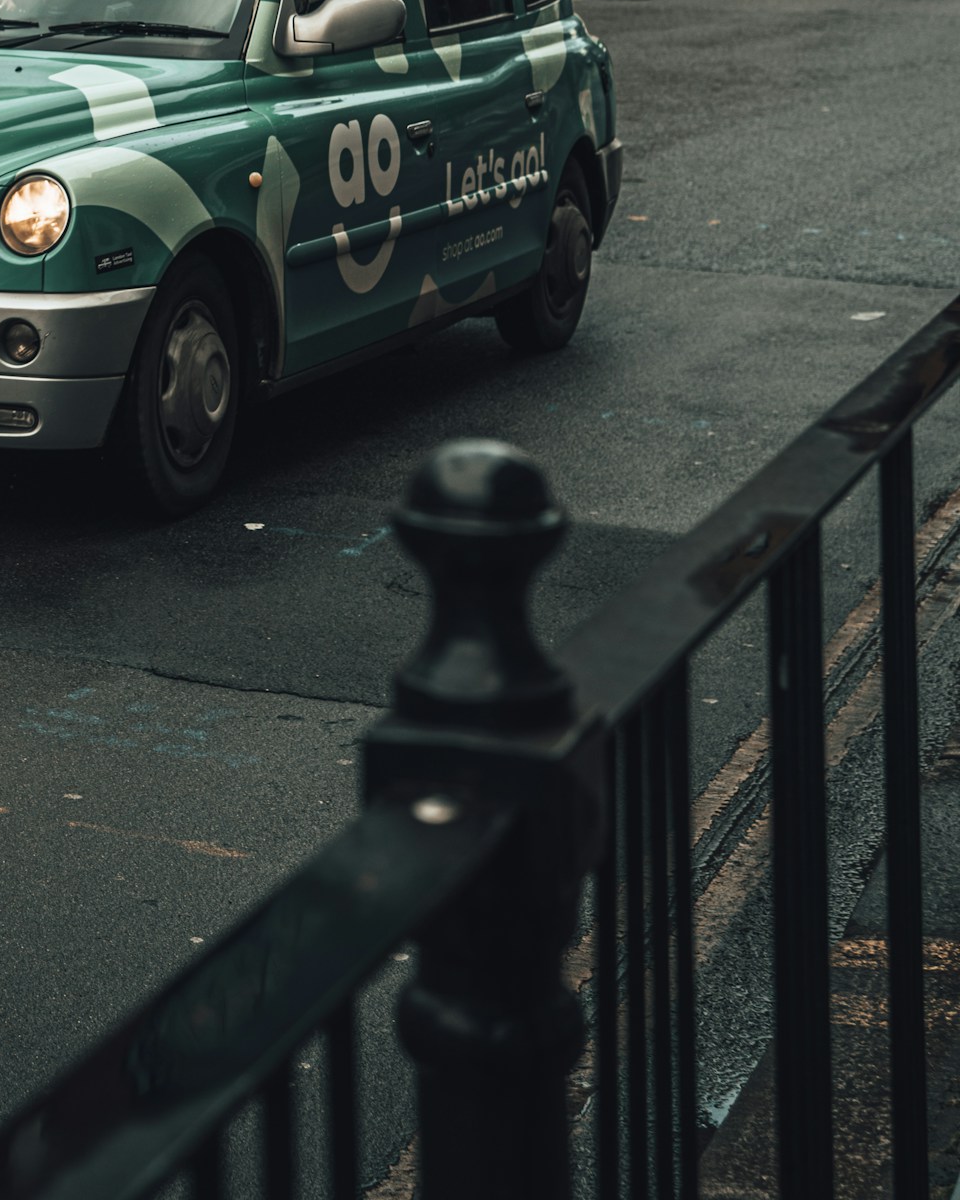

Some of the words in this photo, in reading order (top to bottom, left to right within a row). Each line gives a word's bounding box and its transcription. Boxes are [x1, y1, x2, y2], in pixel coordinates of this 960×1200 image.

[328, 113, 401, 208] ao
[446, 148, 507, 217] Let's
[510, 132, 548, 208] go!
[442, 242, 464, 261] shop
[464, 237, 473, 253] at
[474, 226, 503, 248] ao.com
